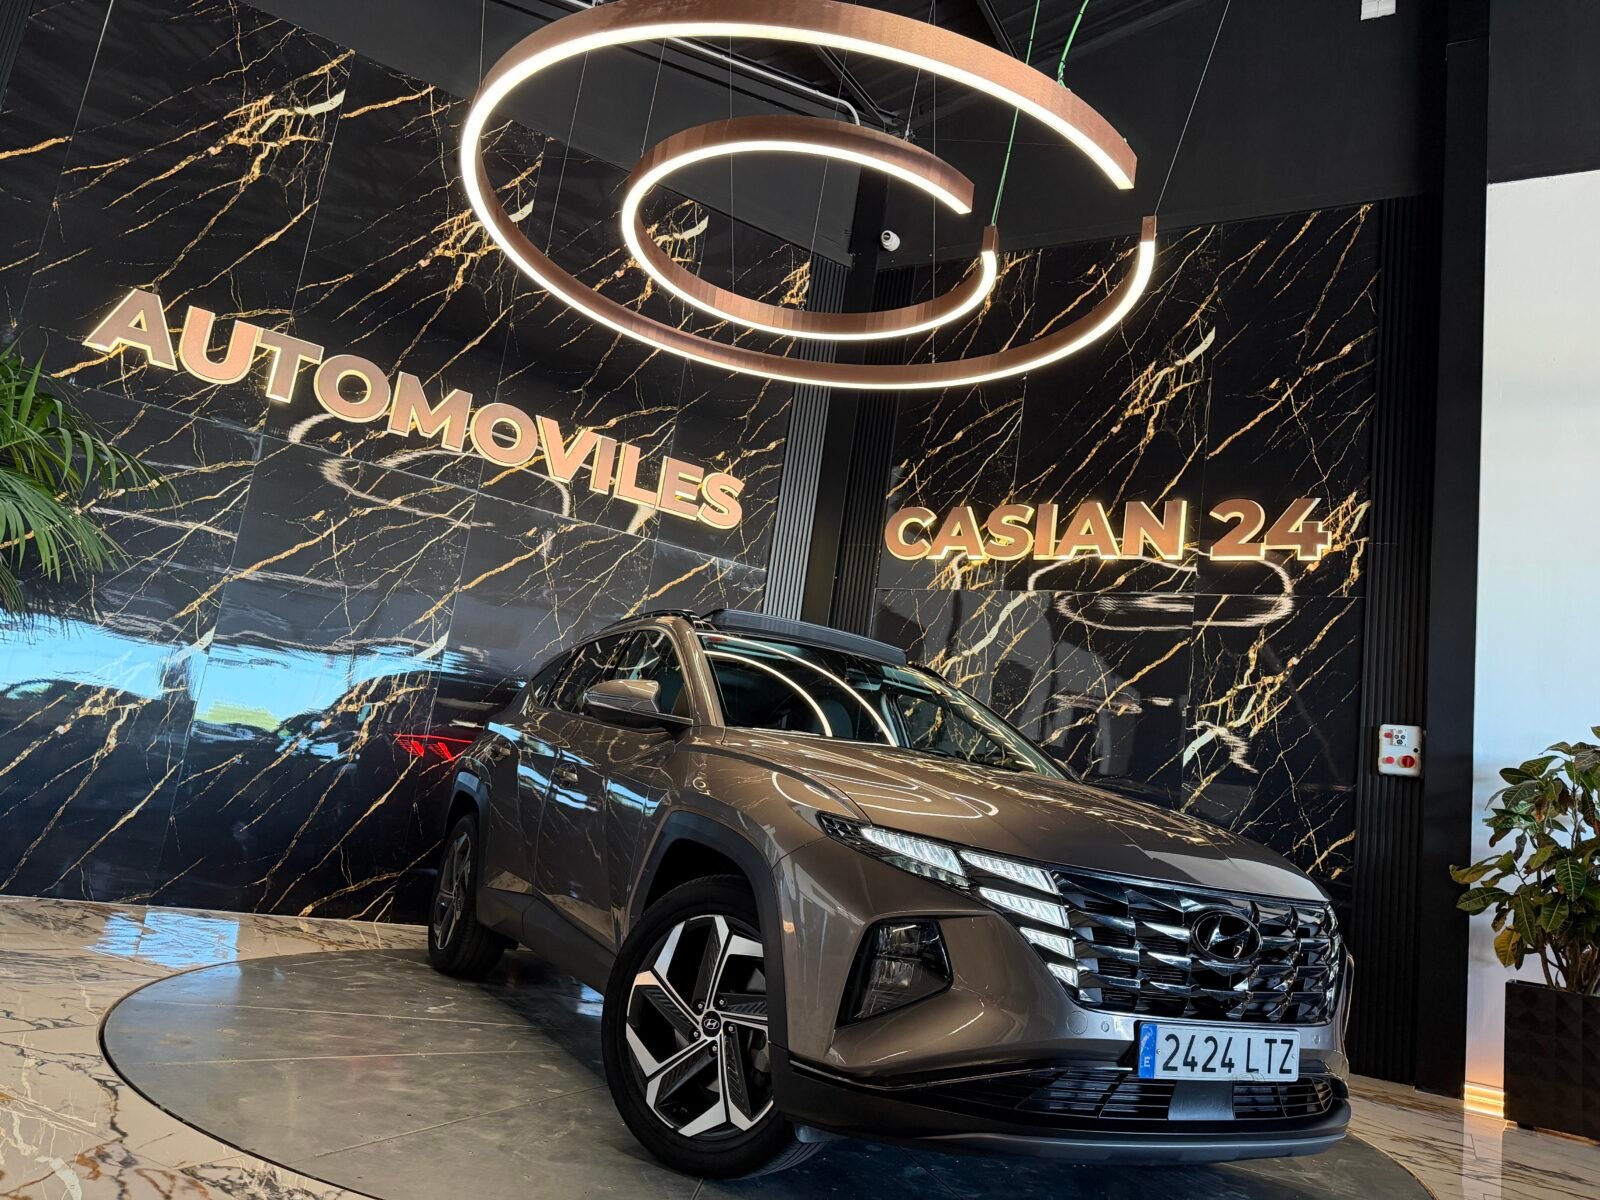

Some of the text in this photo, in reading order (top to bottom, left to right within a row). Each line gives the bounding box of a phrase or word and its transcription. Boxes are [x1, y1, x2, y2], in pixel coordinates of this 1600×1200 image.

[84, 288, 744, 530] AUTOMOVILES
[885, 497, 1332, 561] CASIAN 24
[1143, 1057, 1151, 1067] E
[1162, 1033, 1294, 1075] 2424 LTZ
